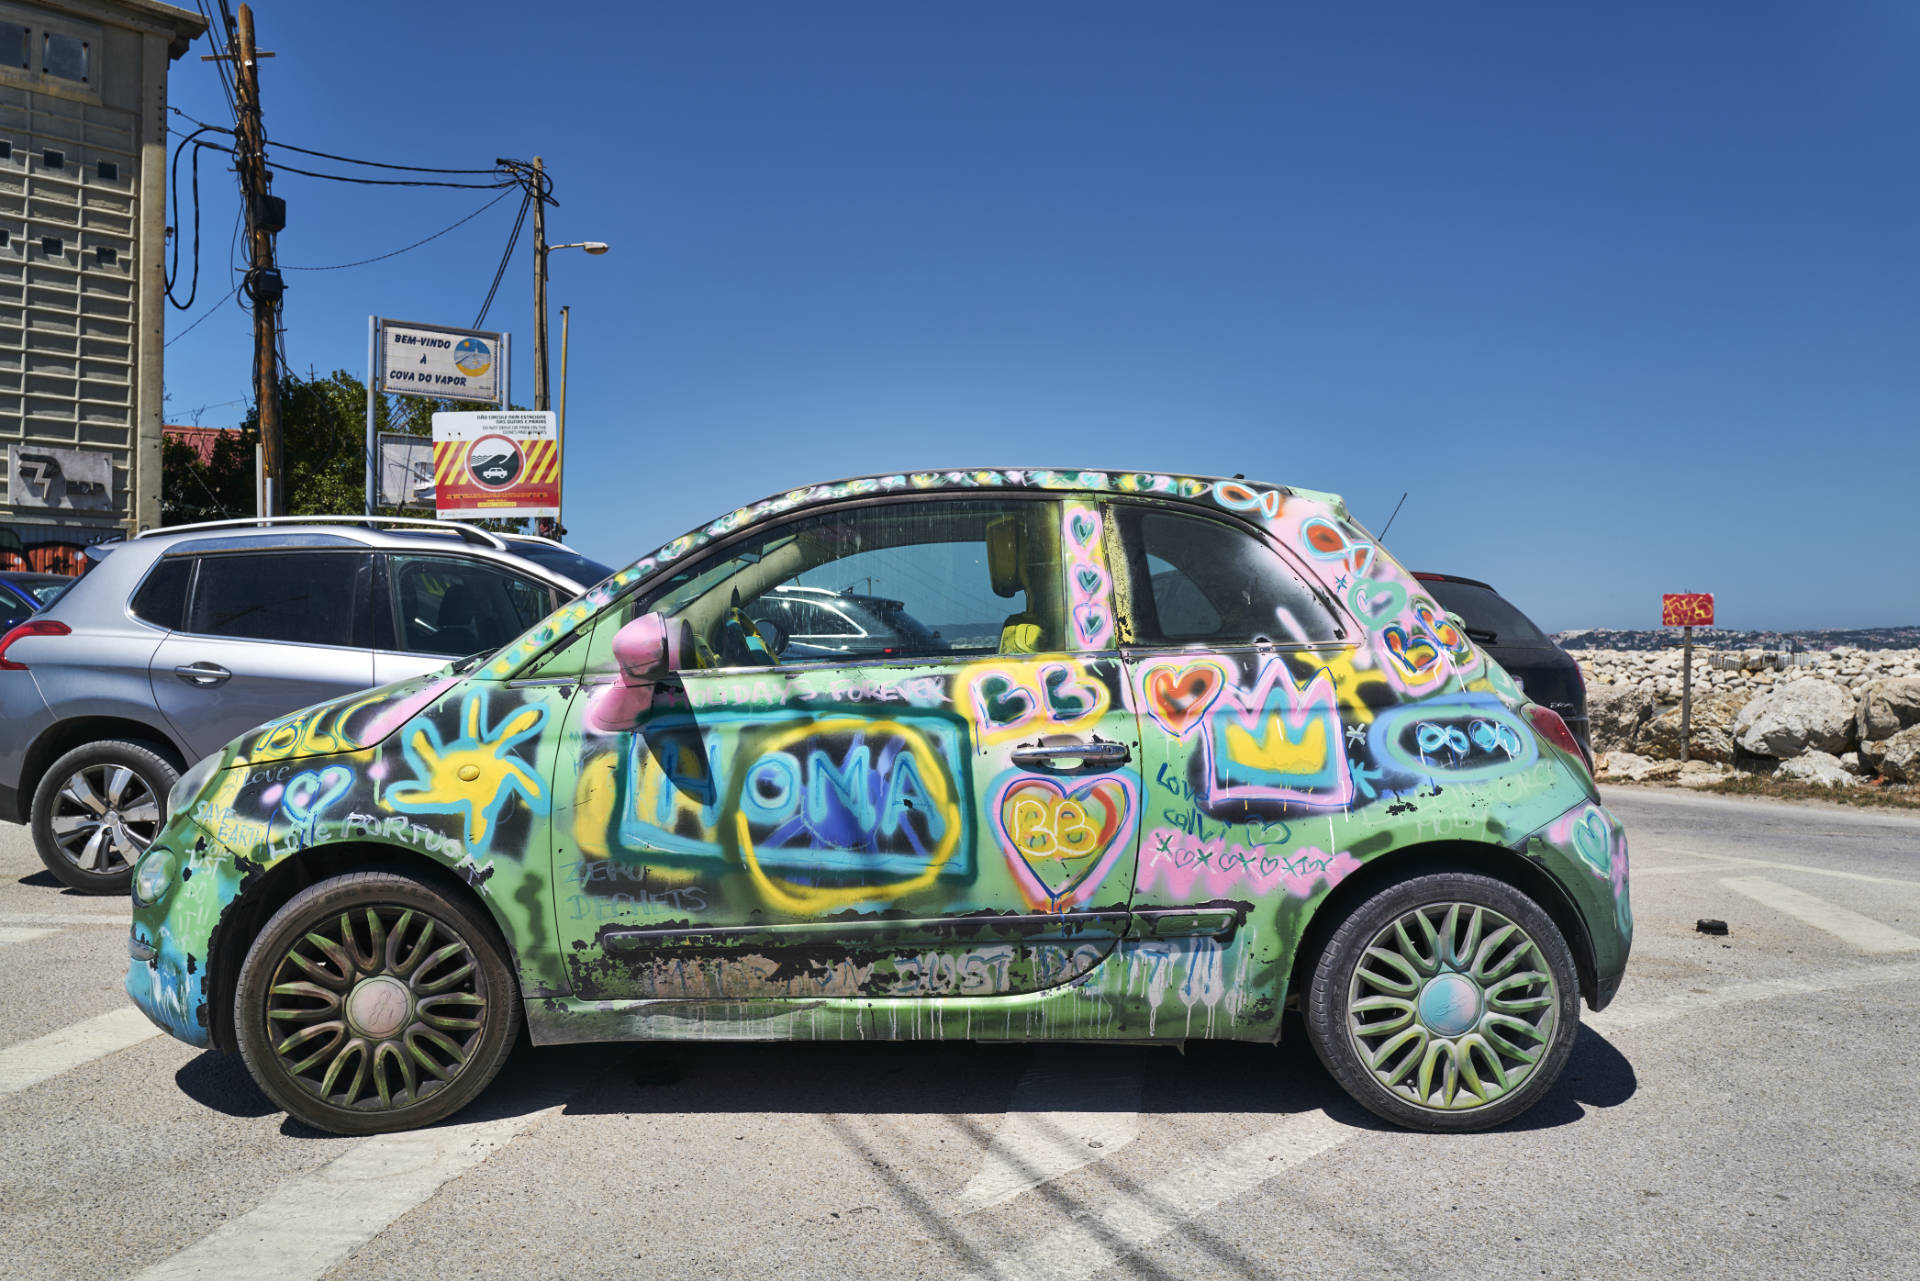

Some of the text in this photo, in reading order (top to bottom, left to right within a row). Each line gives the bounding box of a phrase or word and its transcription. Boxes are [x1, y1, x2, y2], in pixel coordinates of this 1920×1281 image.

[395, 334, 451, 349] BEM-VINDO
[390, 370, 467, 387] COVA DO VAPOR
[1014, 799, 1097, 857] BB
